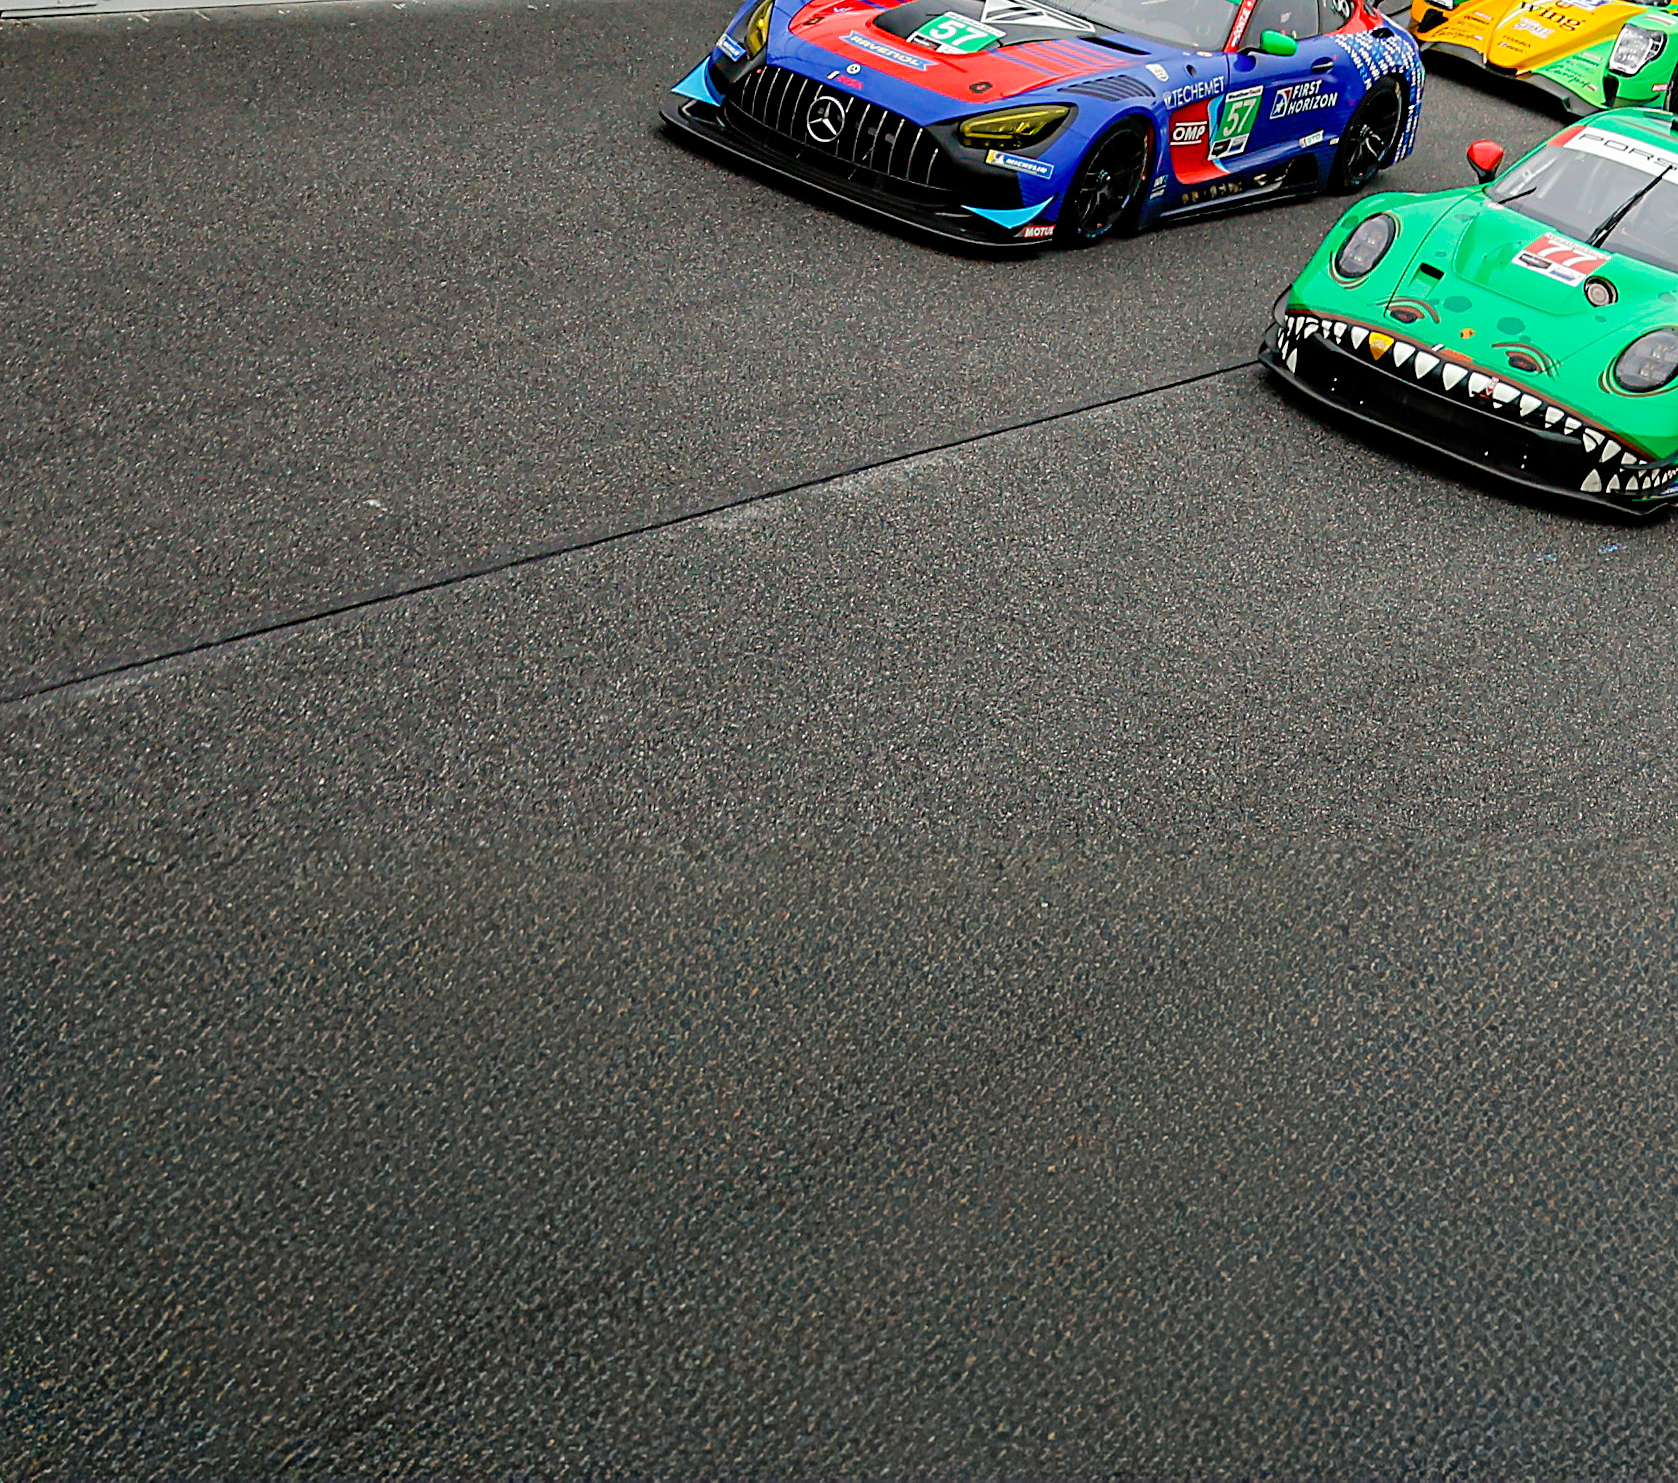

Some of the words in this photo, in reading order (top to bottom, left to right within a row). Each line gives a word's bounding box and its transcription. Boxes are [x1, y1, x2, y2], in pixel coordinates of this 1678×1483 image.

[1521, 1, 1583, 32] wing
[928, 18, 989, 47] 57
[850, 34, 921, 67] RAVENOL
[1171, 75, 1225, 107] TECHEMET
[1292, 79, 1323, 100] FIRST
[1223, 98, 1257, 136] 57
[1287, 92, 1338, 116] HORIZON
[1172, 125, 1207, 142] OMP
[1005, 157, 1048, 175] MICHELIN
[1537, 240, 1599, 267] 77
